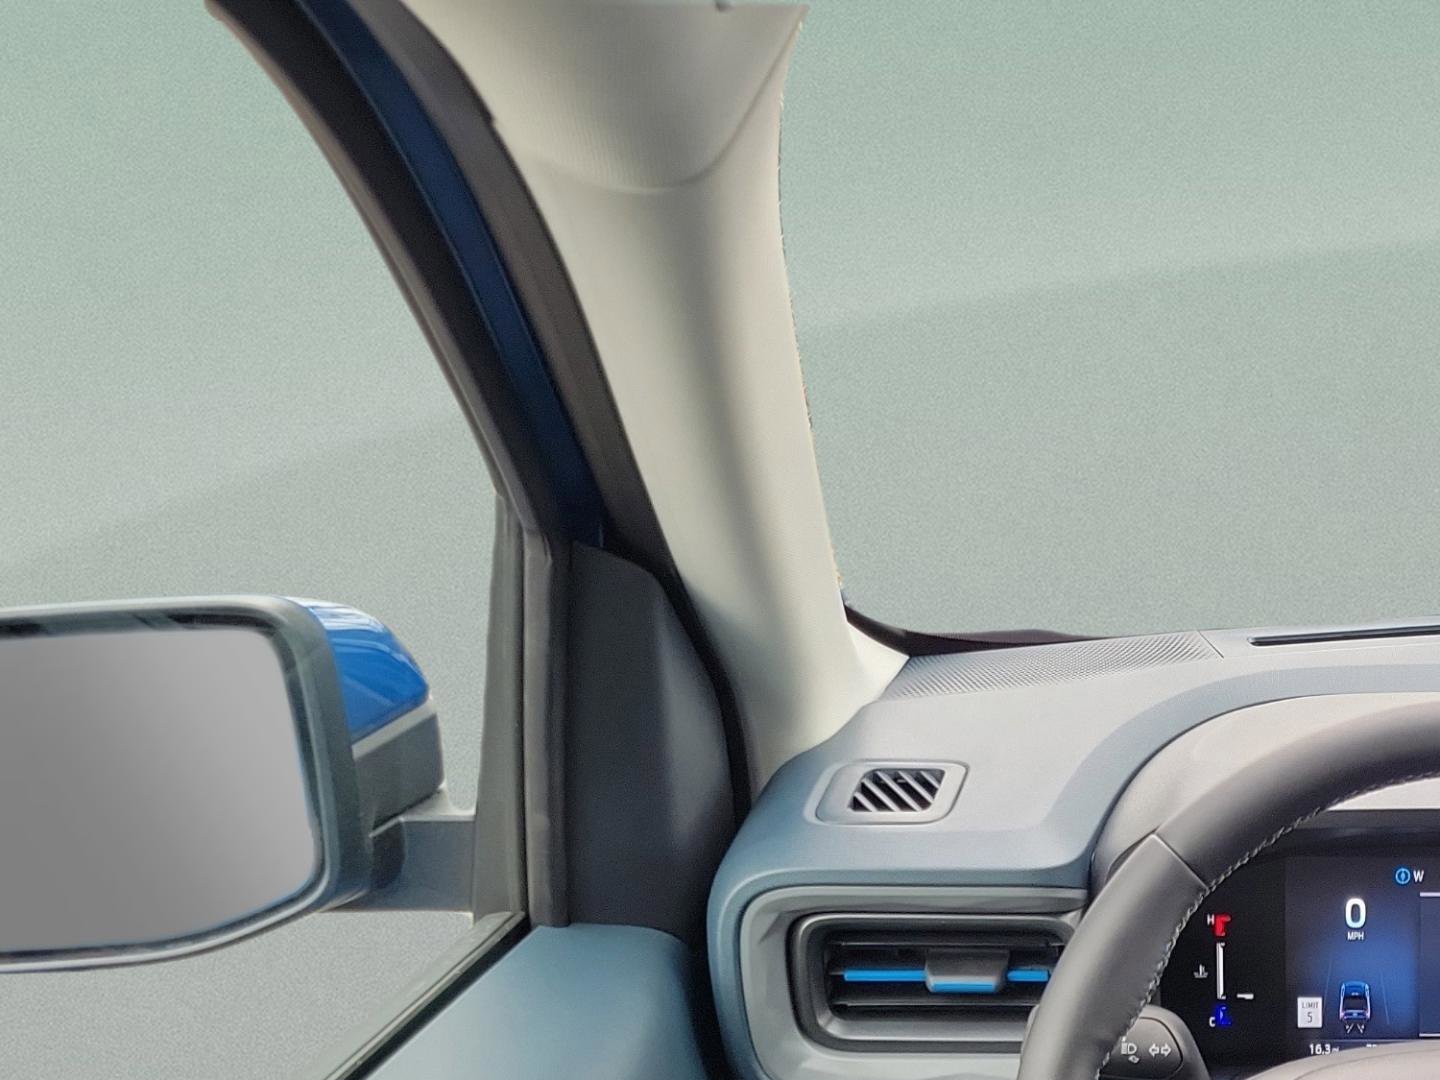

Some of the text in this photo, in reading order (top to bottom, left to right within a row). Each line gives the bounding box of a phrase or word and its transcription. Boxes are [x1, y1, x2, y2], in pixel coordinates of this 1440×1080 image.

[1413, 871, 1425, 882] W
[1345, 898, 1366, 928] 0
[1207, 914, 1215, 925] H
[1347, 931, 1365, 941] MPH
[1208, 1016, 1216, 1028] C
[1307, 1012, 1313, 1024] 5
[1309, 1043, 1331, 1055] 16.3
